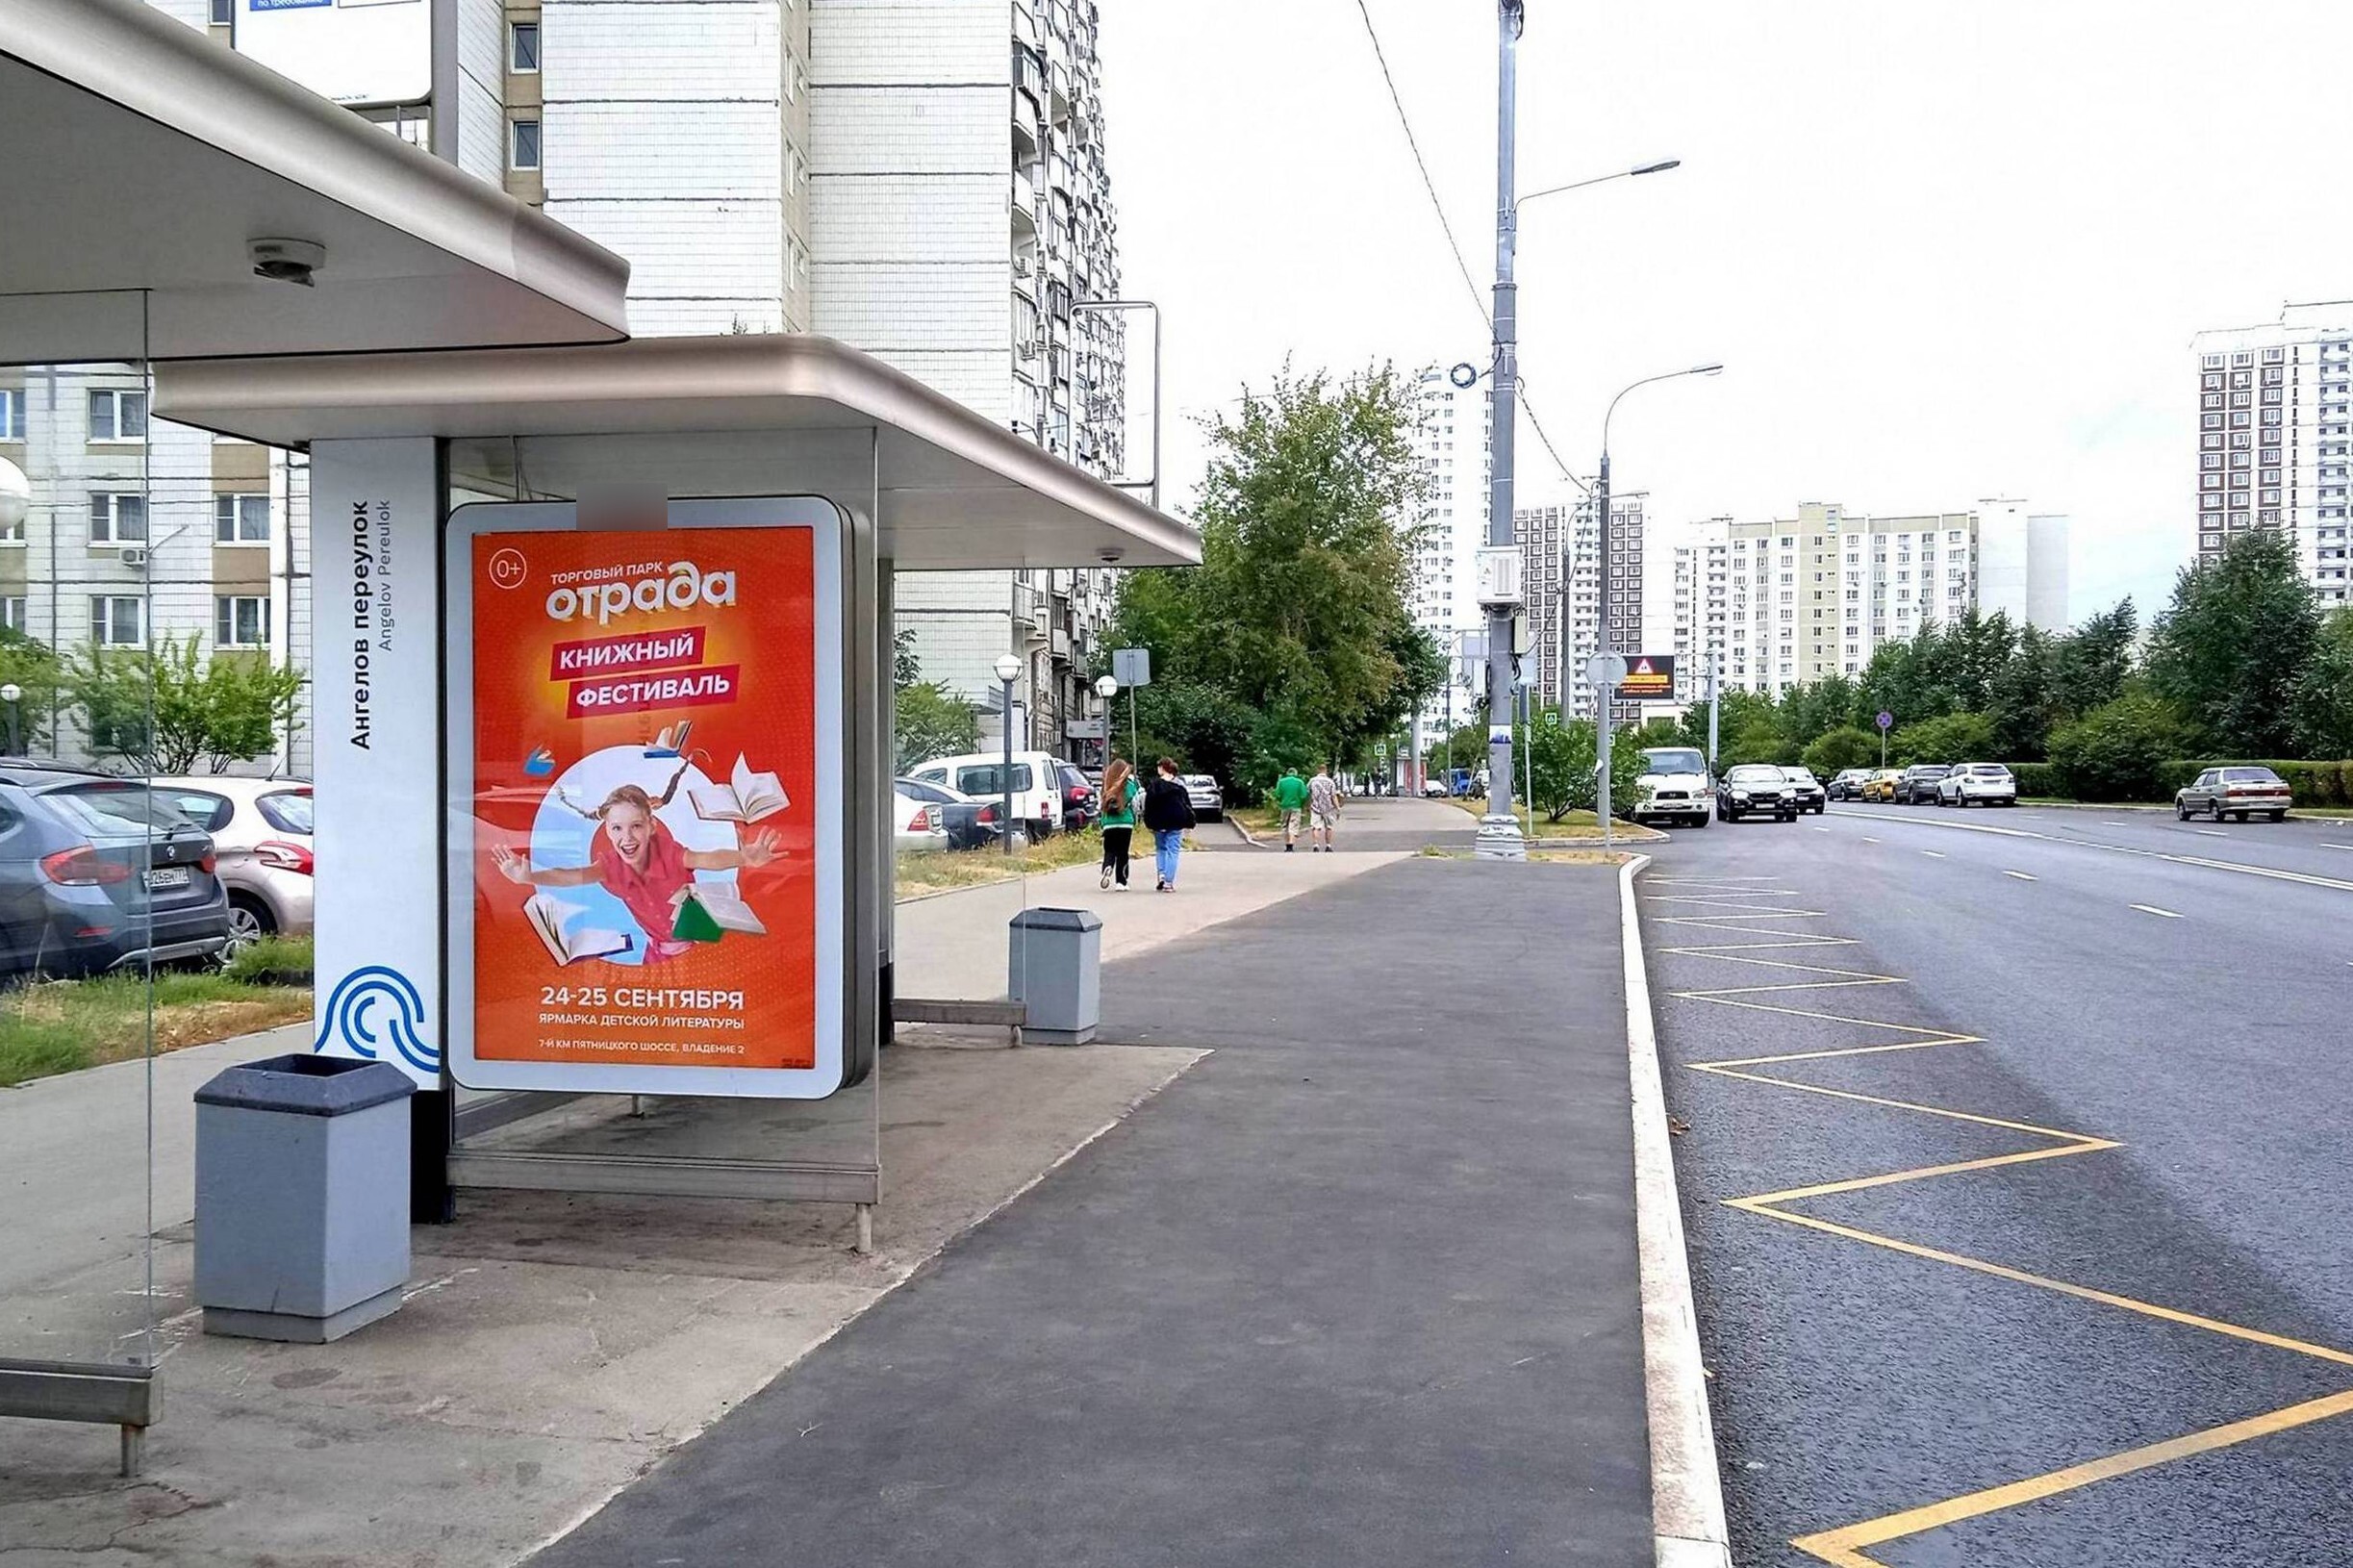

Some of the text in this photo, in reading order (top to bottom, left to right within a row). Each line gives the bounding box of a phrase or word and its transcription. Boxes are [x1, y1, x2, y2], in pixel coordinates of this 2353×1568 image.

[376, 500, 394, 651] Angelov Pereulok
[496, 559, 521, 578] 0+
[550, 561, 664, 585] ТОРГОВЫЙ ПАРК
[545, 561, 736, 627] отрада
[350, 501, 373, 749] Ангелов переулок
[560, 632, 695, 670] КНИЖНЫЙ
[576, 674, 730, 707] ФЕСТИВАЛЬ
[541, 986, 745, 1010] 24-25 СЕНТЯБРЯ
[539, 1013, 745, 1029] ЯРМАРКА ДЕТСКОЙ ЛИТЕРАТУРЫ
[556, 1039, 570, 1049] КМ
[572, 1039, 638, 1050] ПЯТНИЦКОГО
[640, 1042, 679, 1052] ШОССЕ,
[682, 1043, 736, 1054] ВЛАДЕНИЕ
[738, 1045, 746, 1054] 2
